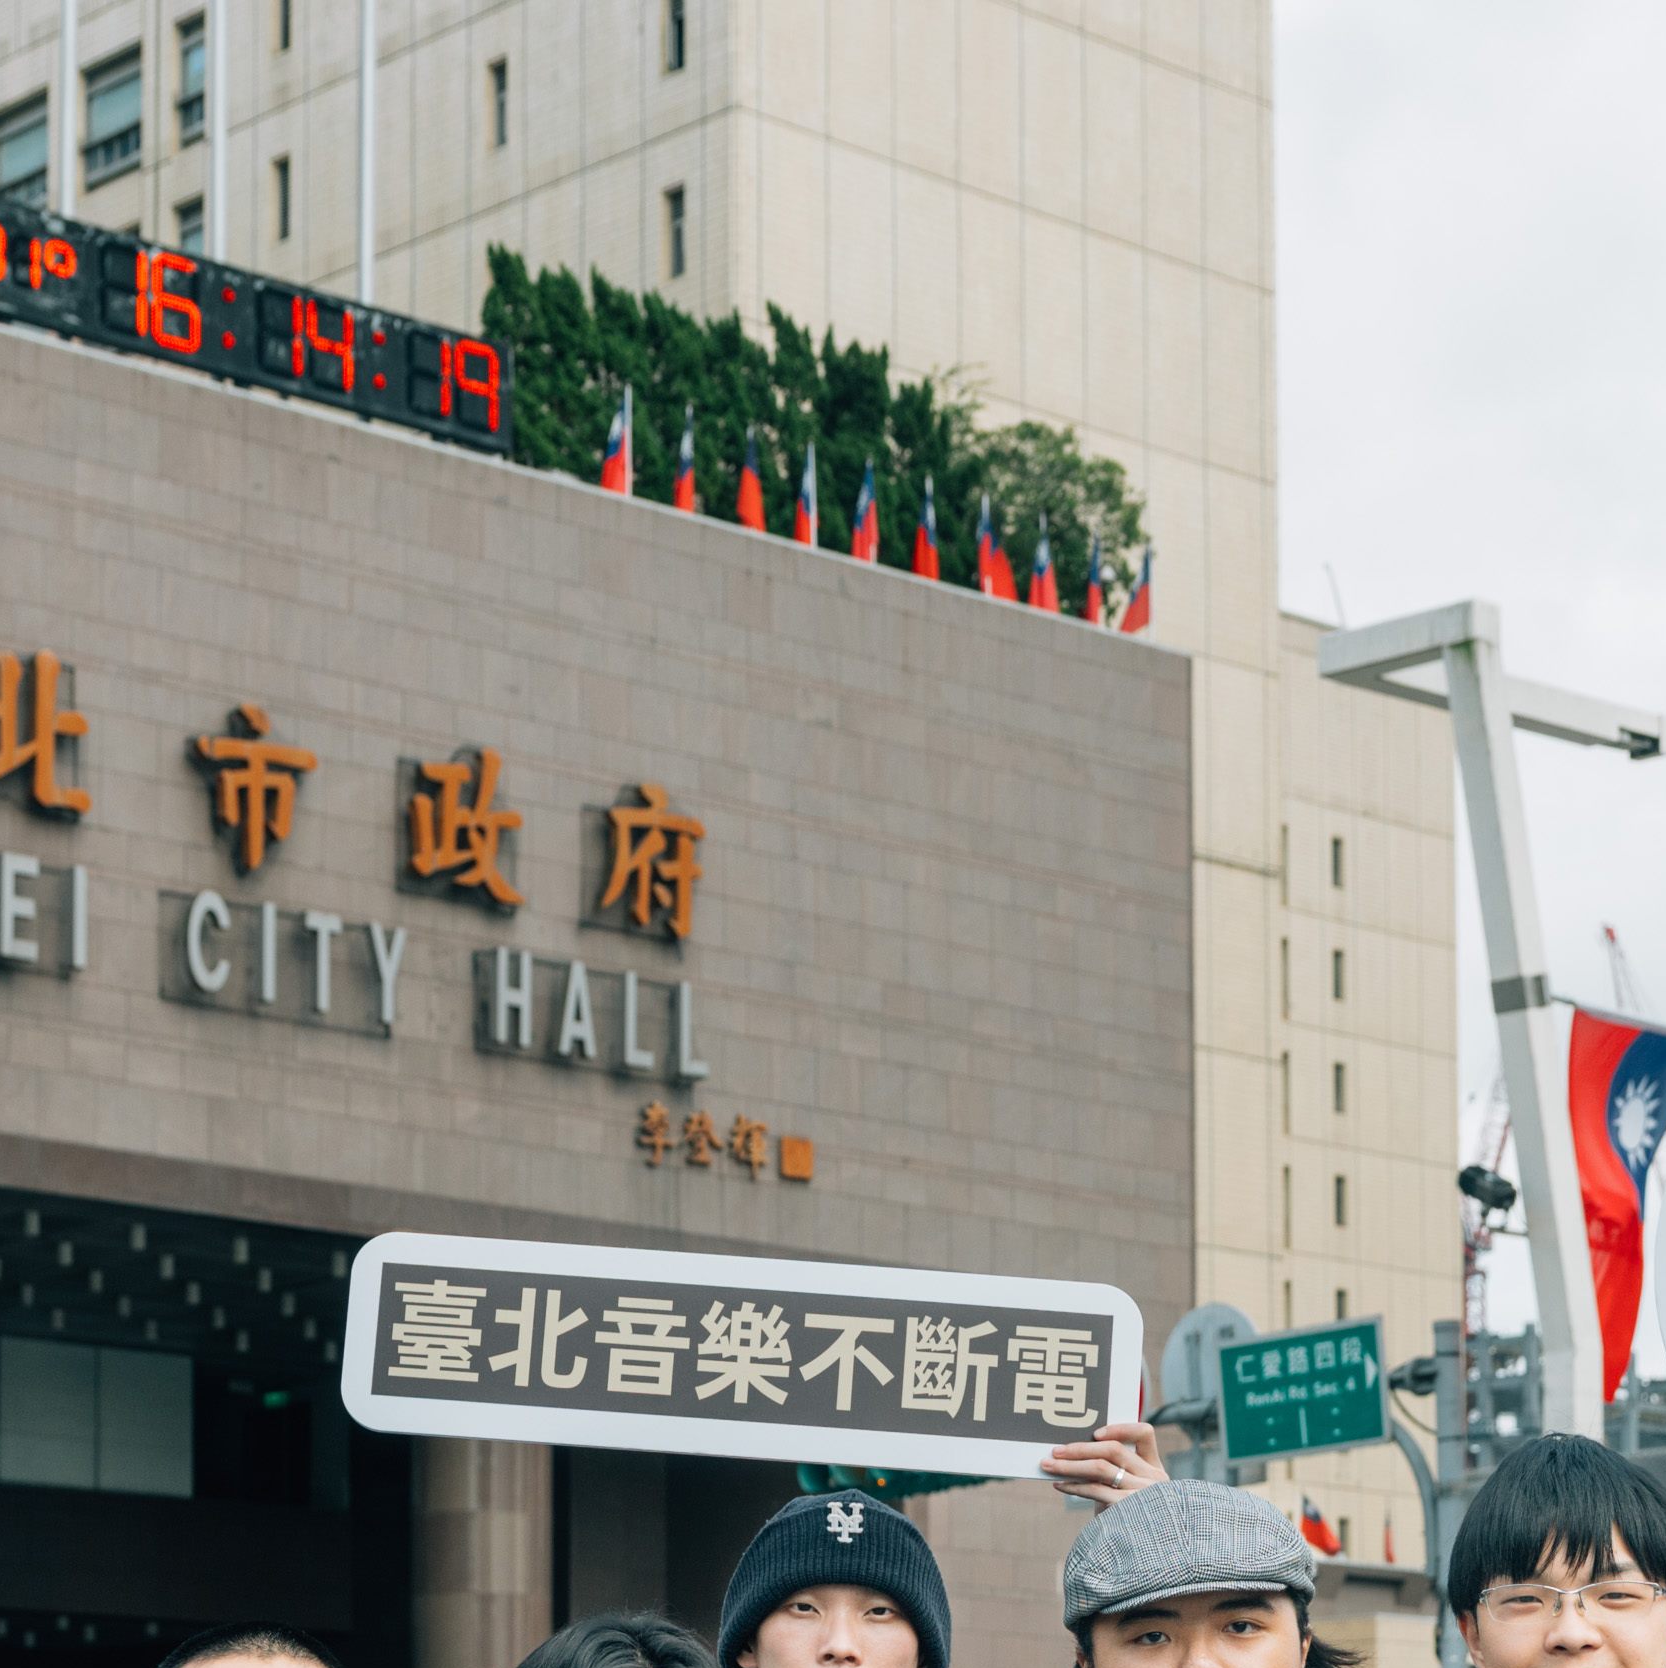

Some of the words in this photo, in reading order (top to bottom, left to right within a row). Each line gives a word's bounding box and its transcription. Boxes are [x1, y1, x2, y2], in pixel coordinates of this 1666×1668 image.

[186, 891, 406, 1026] CITY
[495, 946, 709, 1081] HALL
[387, 1279, 1100, 1430] 臺北音樂不斷電
[1235, 1336, 1363, 1384] 仁愛路四段
